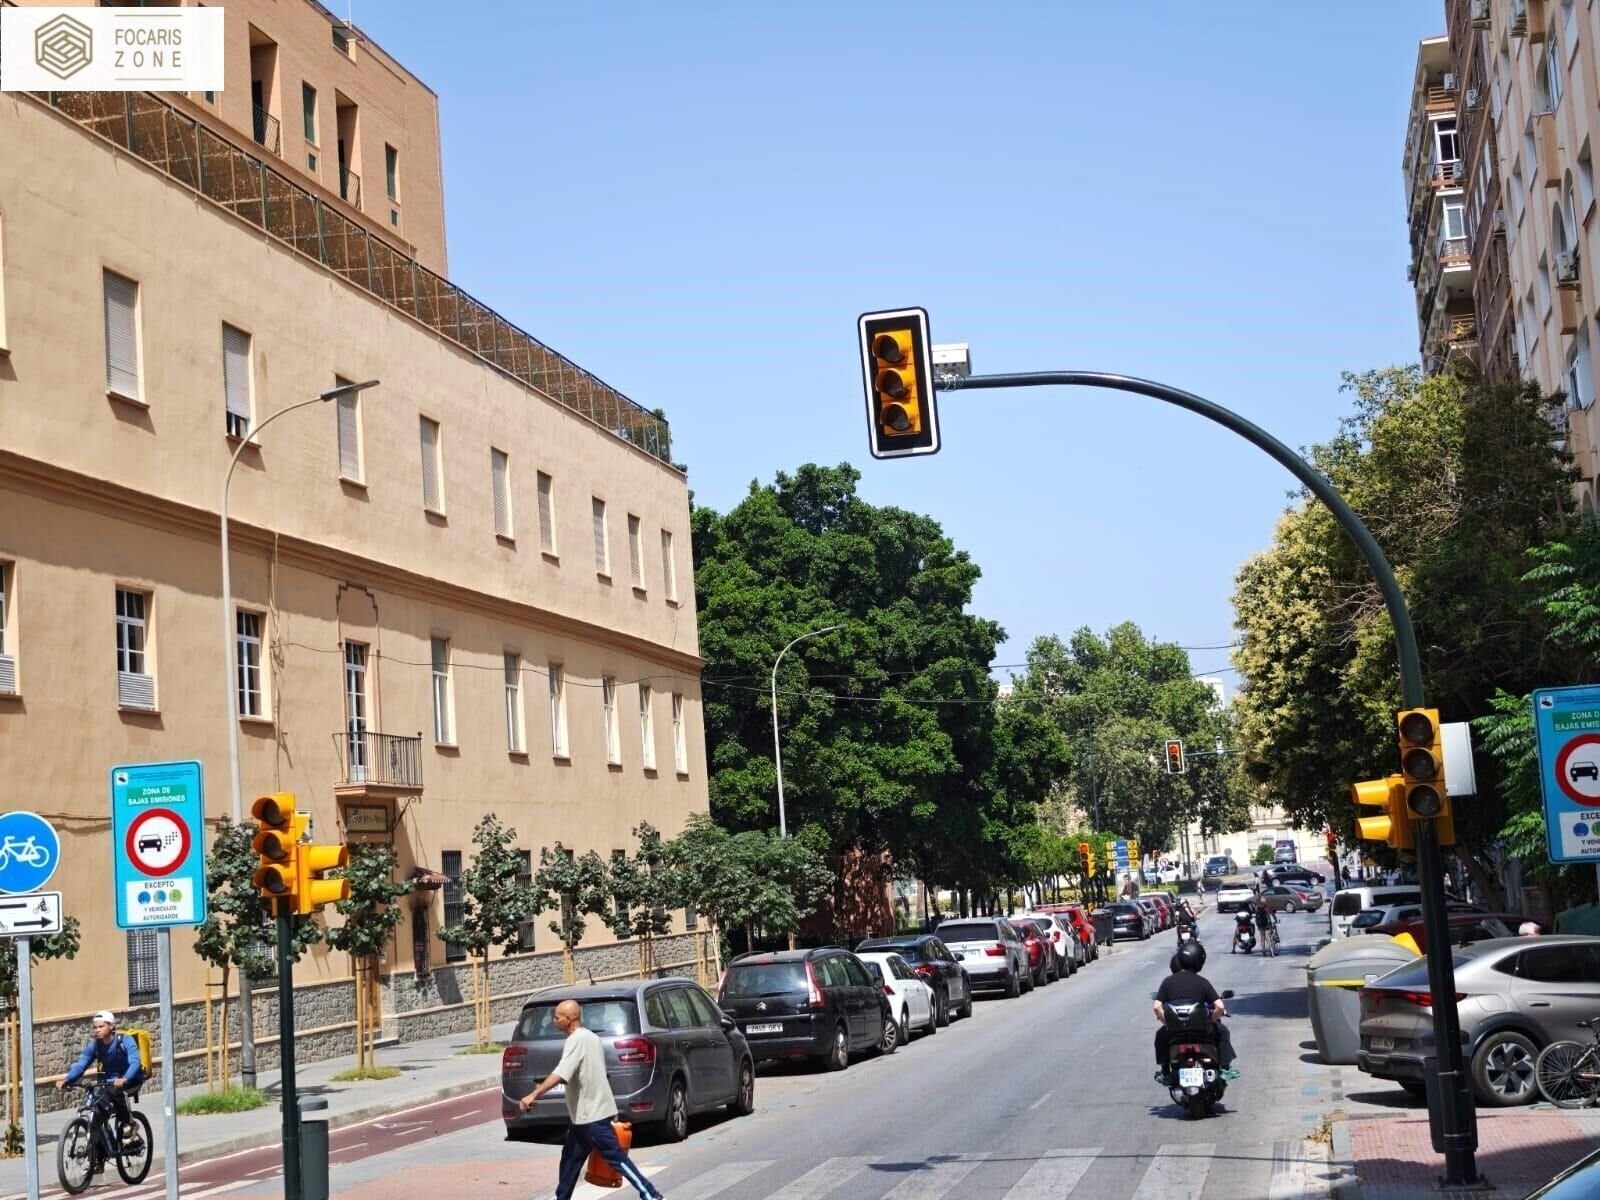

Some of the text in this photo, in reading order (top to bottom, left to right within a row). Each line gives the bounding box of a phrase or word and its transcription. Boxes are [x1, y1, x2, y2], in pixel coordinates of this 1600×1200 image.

[1570, 712, 1592, 720] ZONA
[1555, 722, 1579, 731] BAJAS
[142, 786, 171, 795] ZONA DE
[128, 794, 186, 806] BAJAS EMISIONES
[144, 880, 175, 889] EXCEPTO
[143, 913, 179, 921] AUTORIZADOS
